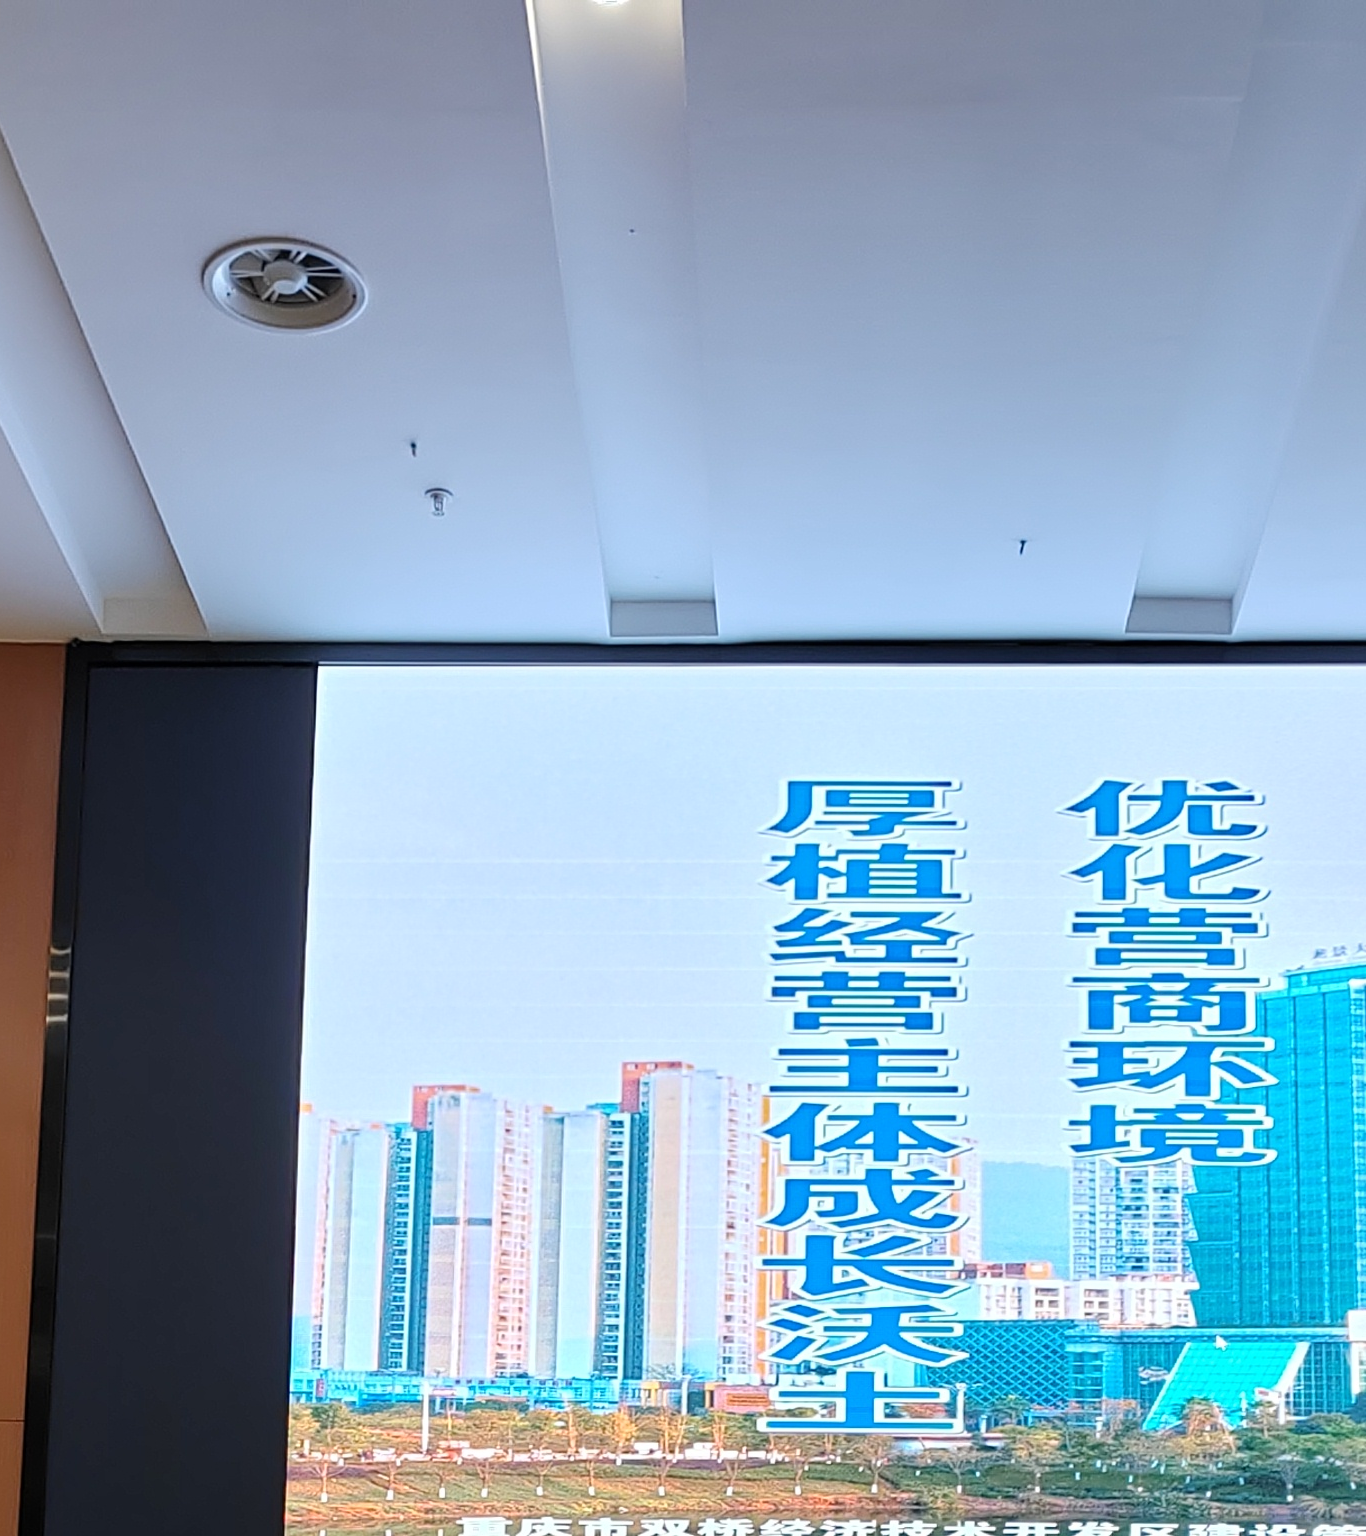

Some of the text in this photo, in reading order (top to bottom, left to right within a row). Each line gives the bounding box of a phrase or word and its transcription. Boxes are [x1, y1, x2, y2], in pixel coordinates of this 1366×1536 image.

[758, 779, 971, 1434] 厚植经营主体成长沃土
[1060, 779, 1278, 1166] 优化营商环境
